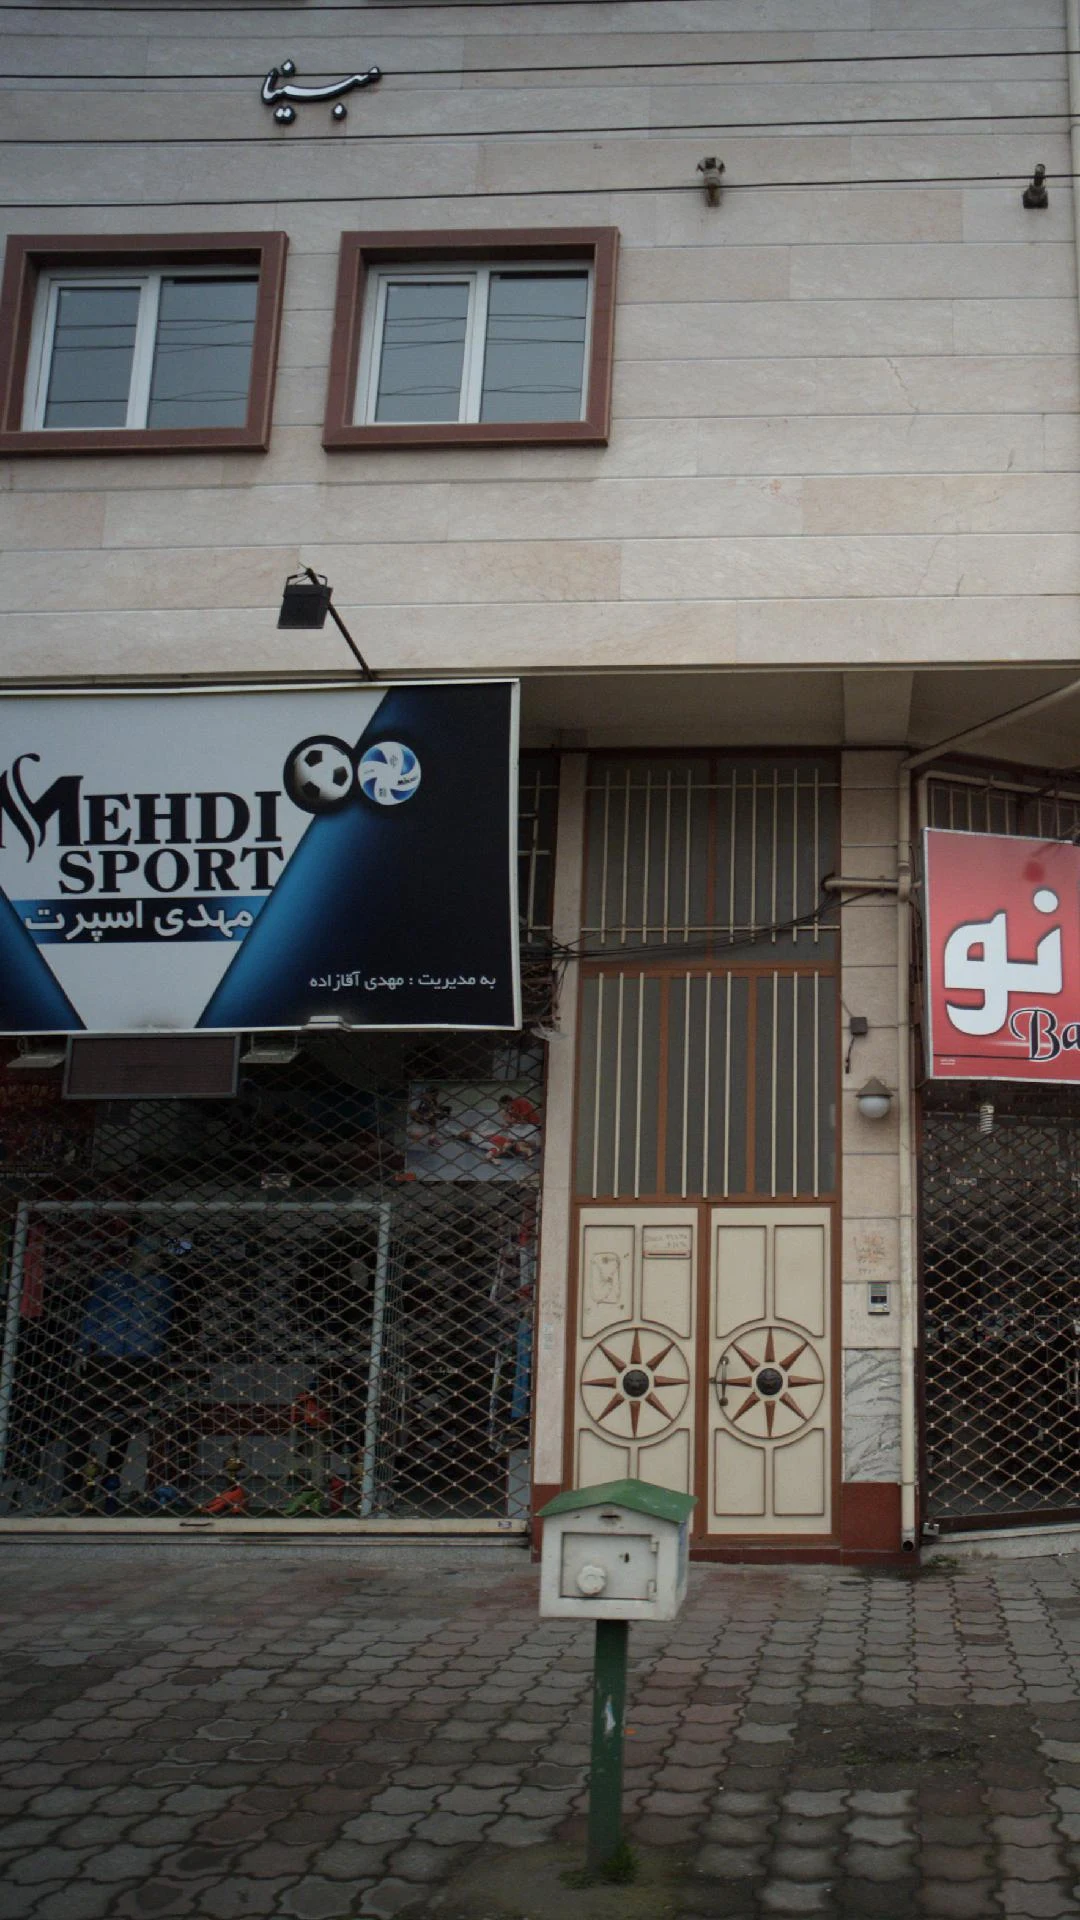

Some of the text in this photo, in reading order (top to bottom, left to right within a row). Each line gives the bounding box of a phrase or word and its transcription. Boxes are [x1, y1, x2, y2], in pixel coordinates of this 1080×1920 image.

[0, 753, 282, 863] MEHDI
[58, 847, 284, 895] SPORT
[25, 899, 254, 942] مهدی اسپرت
[309, 971, 361, 992] آقازاده
[364, 975, 405, 990] مهدی
[417, 974, 477, 990] مدیریت
[479, 974, 497, 989] به
